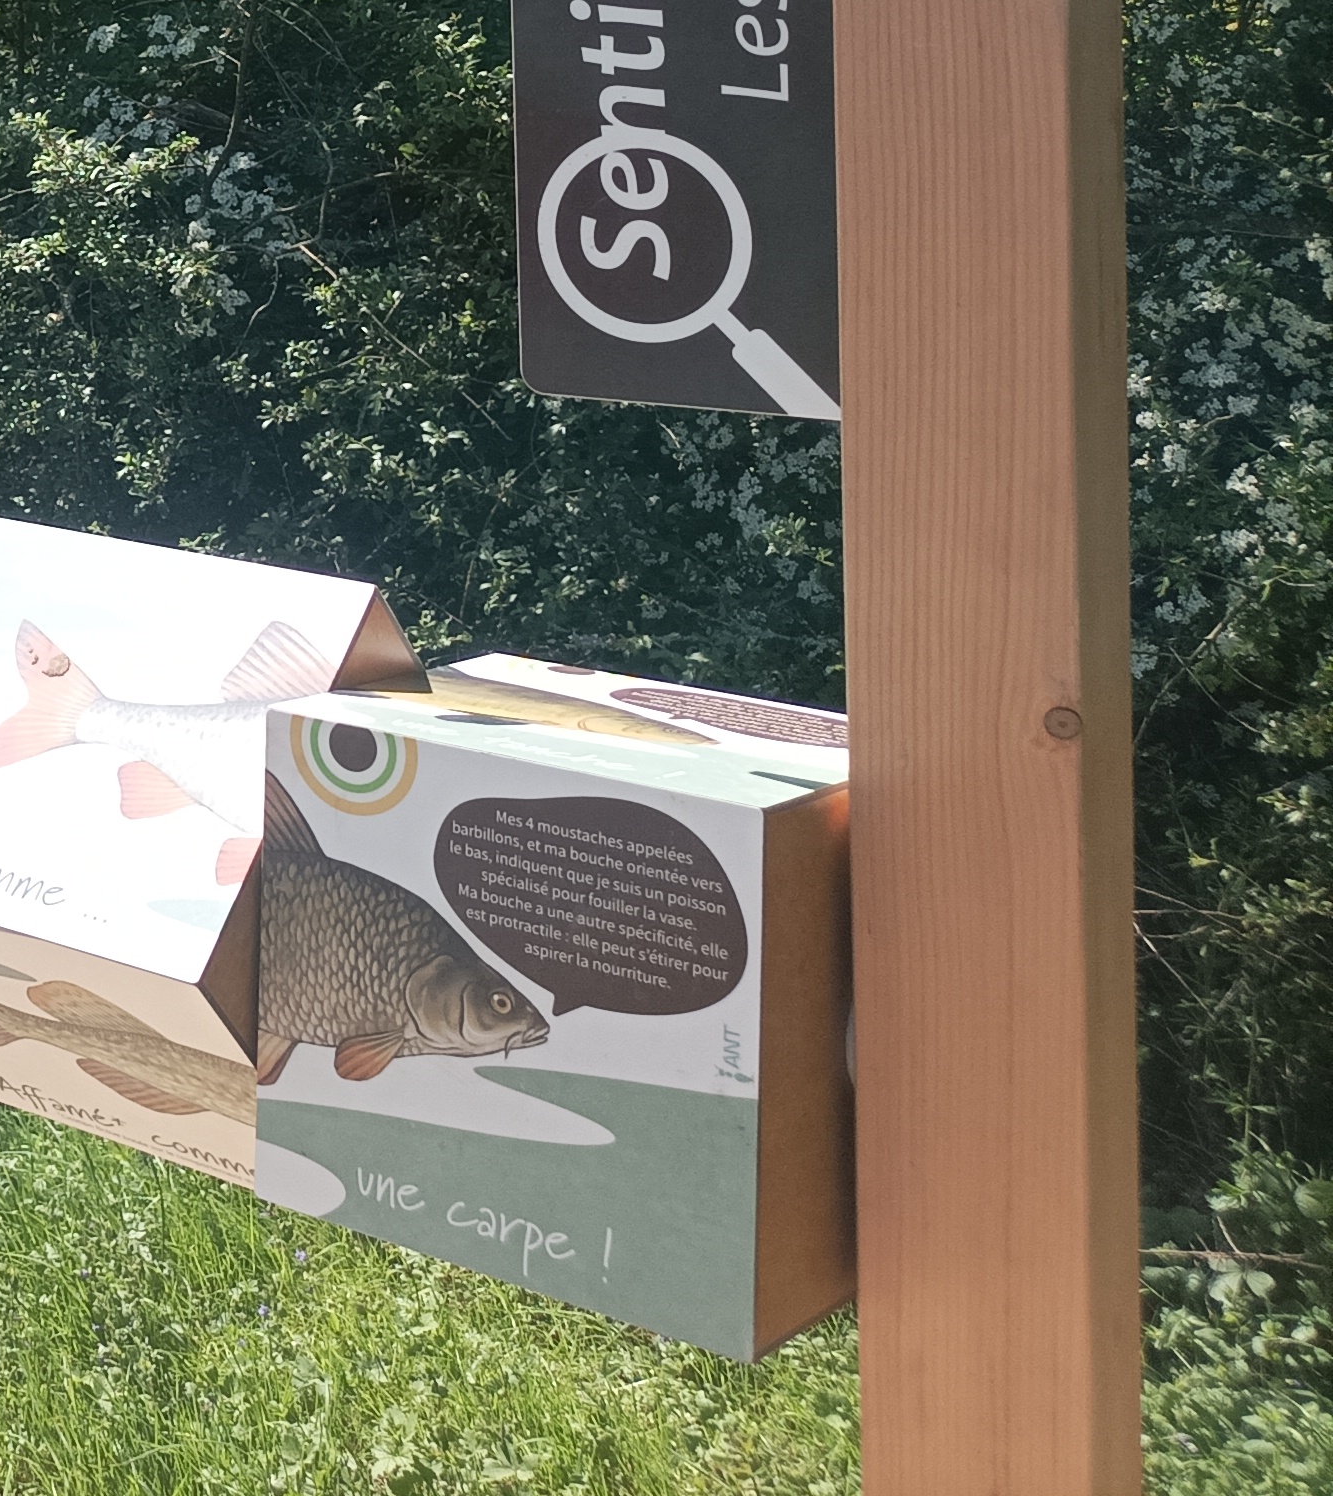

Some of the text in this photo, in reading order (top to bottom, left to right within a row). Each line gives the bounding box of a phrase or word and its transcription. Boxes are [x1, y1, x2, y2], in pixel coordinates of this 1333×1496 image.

[451, 819, 724, 894] barbillons, et ma bouche orientée vers
[495, 809, 524, 829] Mes
[537, 821, 624, 850] moustaches
[625, 840, 694, 866] appelées
[449, 838, 727, 917] le bas, indiquent que je suis un poisson
[480, 870, 698, 932] spécialisé pour fouiller la vase.
[457, 882, 479, 900] Ma
[480, 886, 533, 913] bouche
[546, 906, 575, 923] une
[574, 913, 617, 934] autre
[617, 923, 698, 955] spécificité,
[700, 941, 729, 961] elle
[465, 907, 487, 923] est
[488, 913, 563, 941] protractile
[571, 931, 600, 950] elle
[601, 940, 636, 960] peut
[637, 947, 690, 972] s'étirer
[691, 962, 730, 982] pour
[523, 942, 672, 990] aspirer la nourriture.
[356, 1165, 613, 1285] une carpe !
